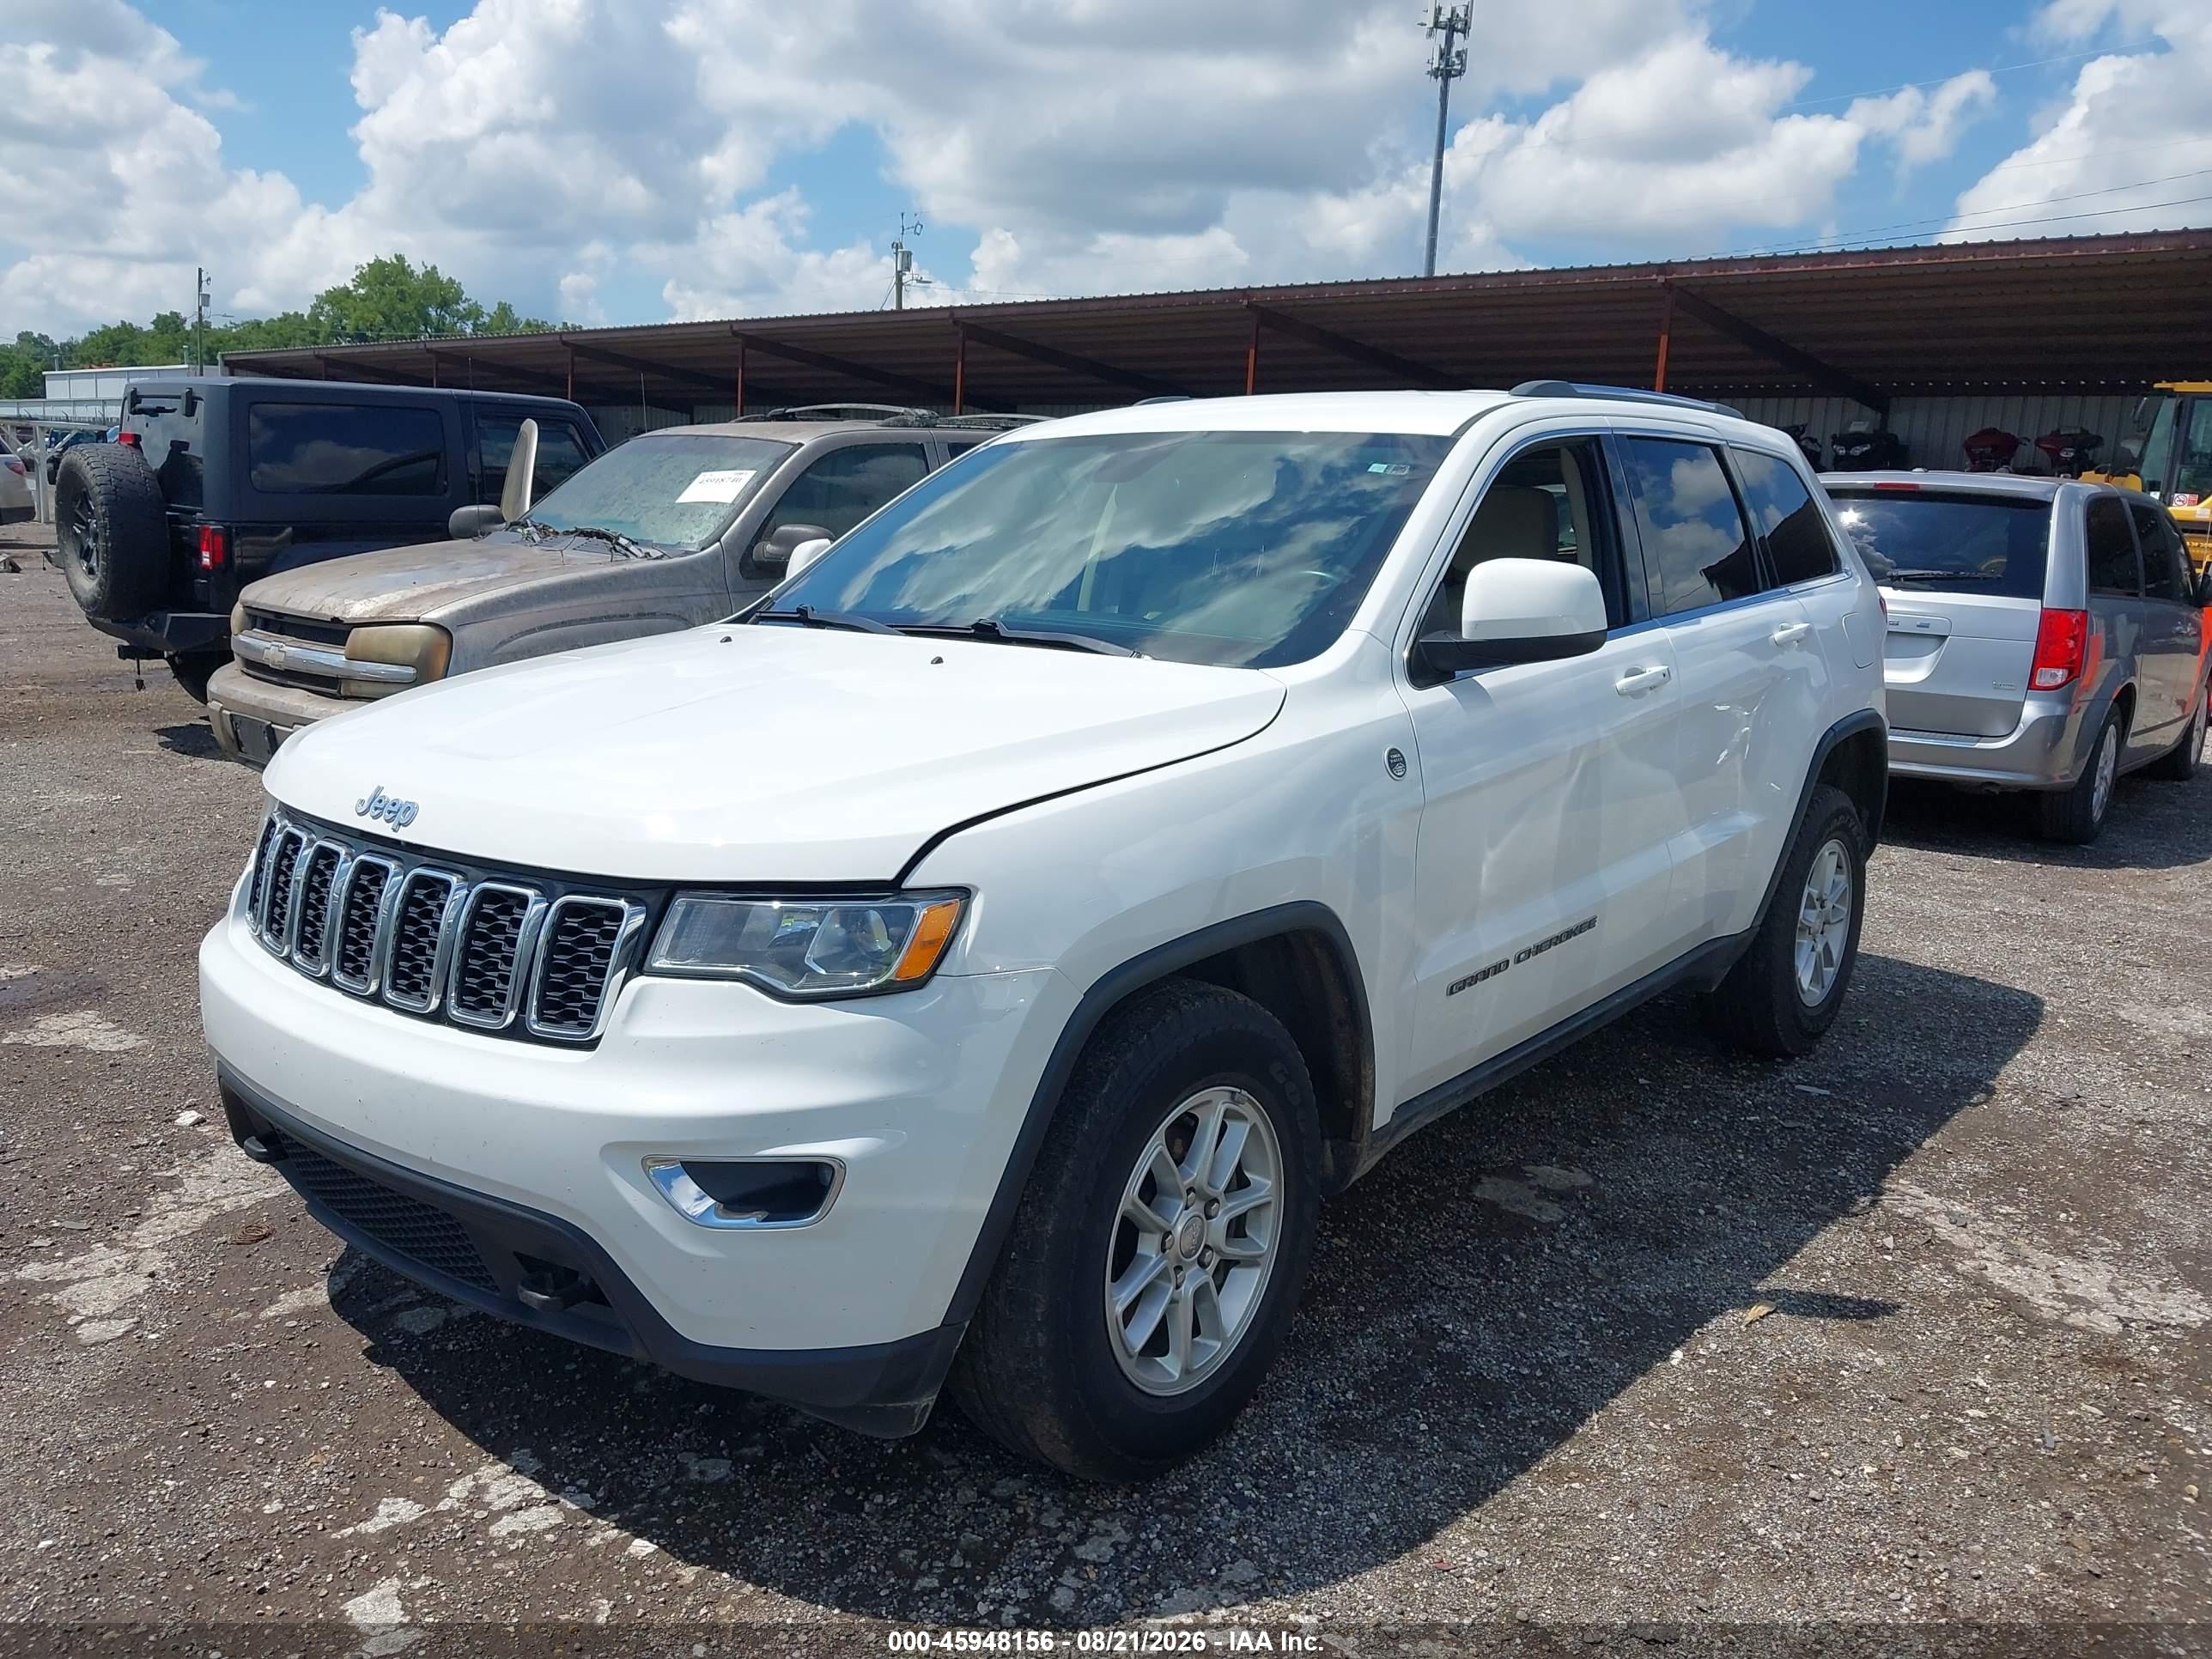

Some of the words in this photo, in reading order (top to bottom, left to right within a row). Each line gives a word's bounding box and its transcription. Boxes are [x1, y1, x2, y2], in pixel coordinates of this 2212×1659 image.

[355, 785, 419, 833] Jeep
[1446, 958, 1510, 996] GRAND
[1514, 915, 1598, 964] CHEROKEE
